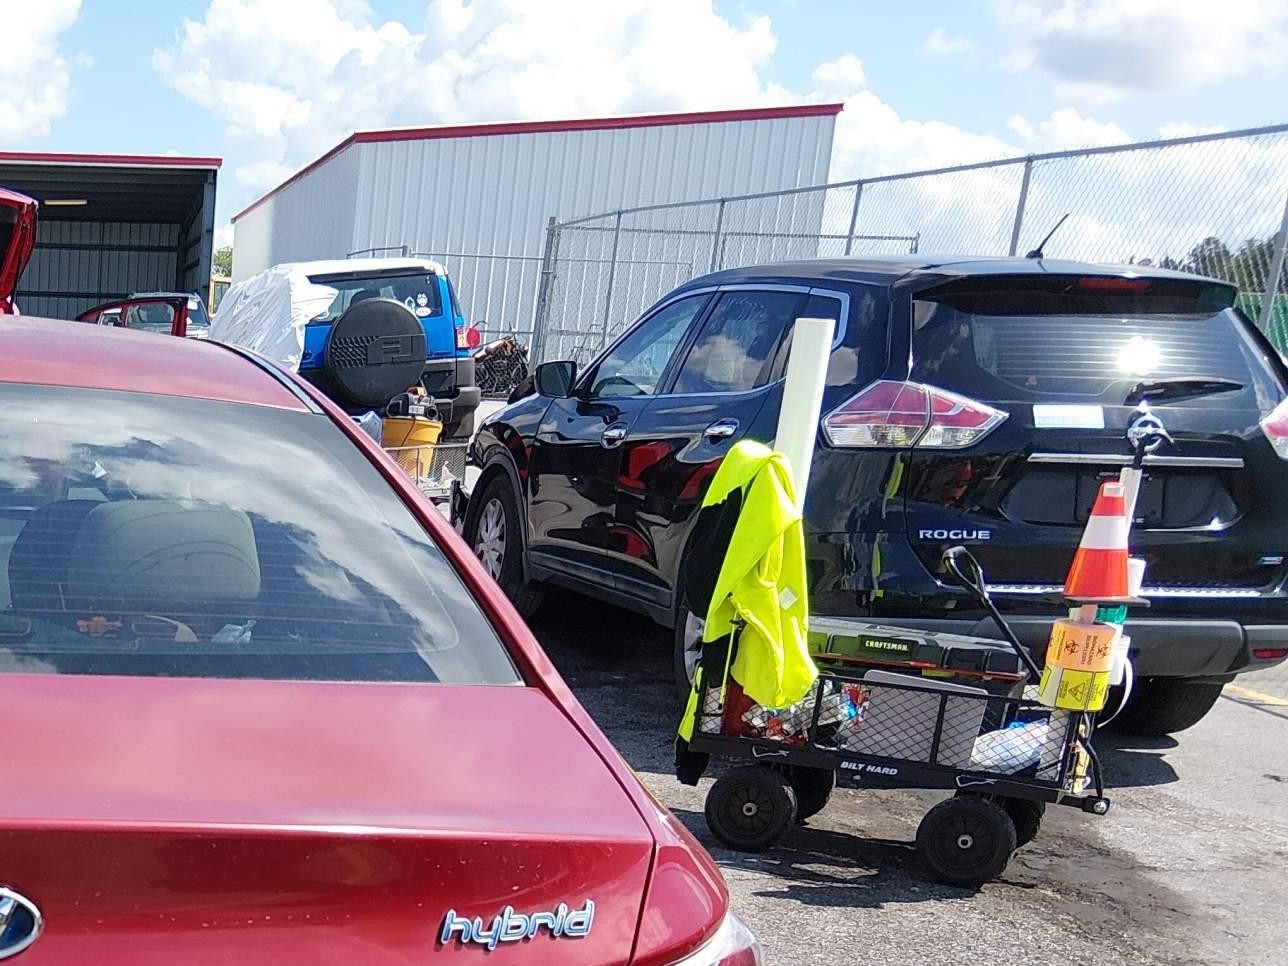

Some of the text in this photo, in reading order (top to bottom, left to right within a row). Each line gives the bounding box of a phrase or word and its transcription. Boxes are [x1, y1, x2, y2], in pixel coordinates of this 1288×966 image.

[919, 529, 991, 540] ROGUE
[840, 761, 899, 776] BILT HARD
[441, 898, 595, 951] hybrid
